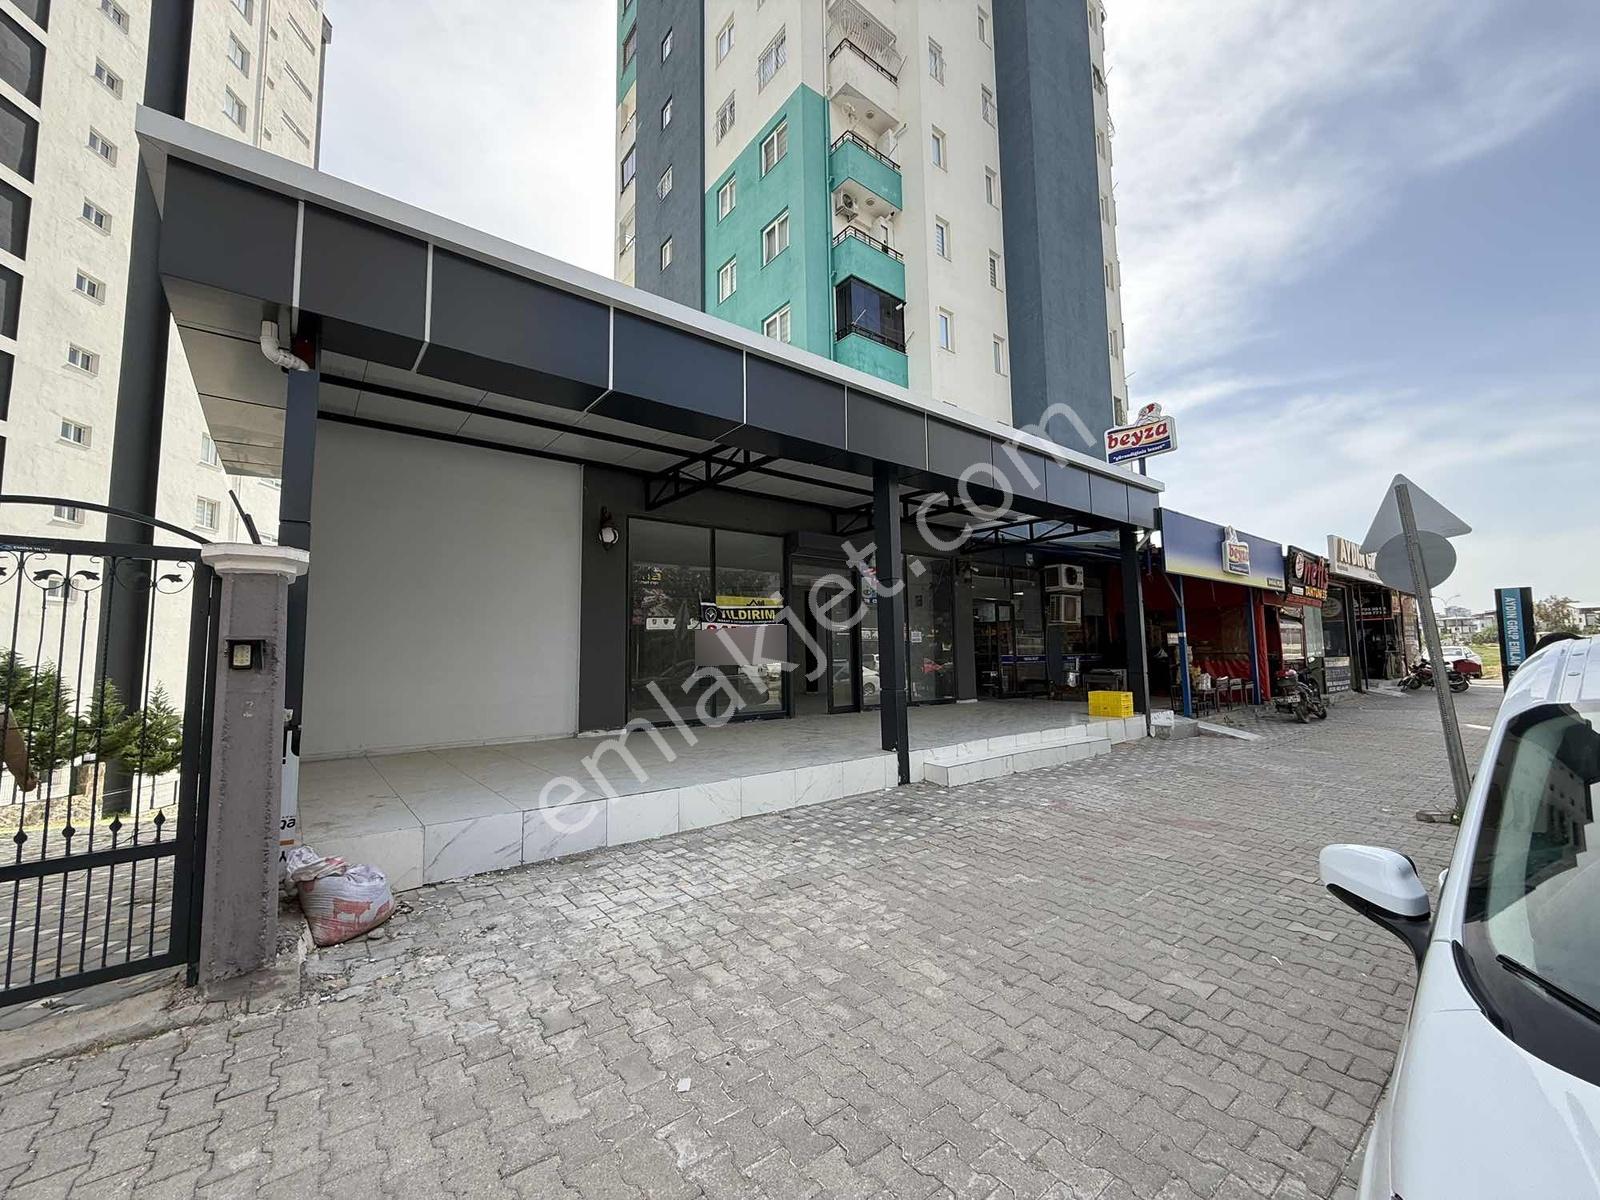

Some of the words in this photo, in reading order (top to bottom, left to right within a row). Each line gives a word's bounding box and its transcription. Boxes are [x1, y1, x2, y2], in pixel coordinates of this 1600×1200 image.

[1106, 422, 1168, 449] beyza
[1340, 538, 1365, 568] AYDIN
[1504, 597, 1518, 619] AYDIN
[1506, 619, 1520, 641] GRUP
[1508, 641, 1523, 666] EMLAK
